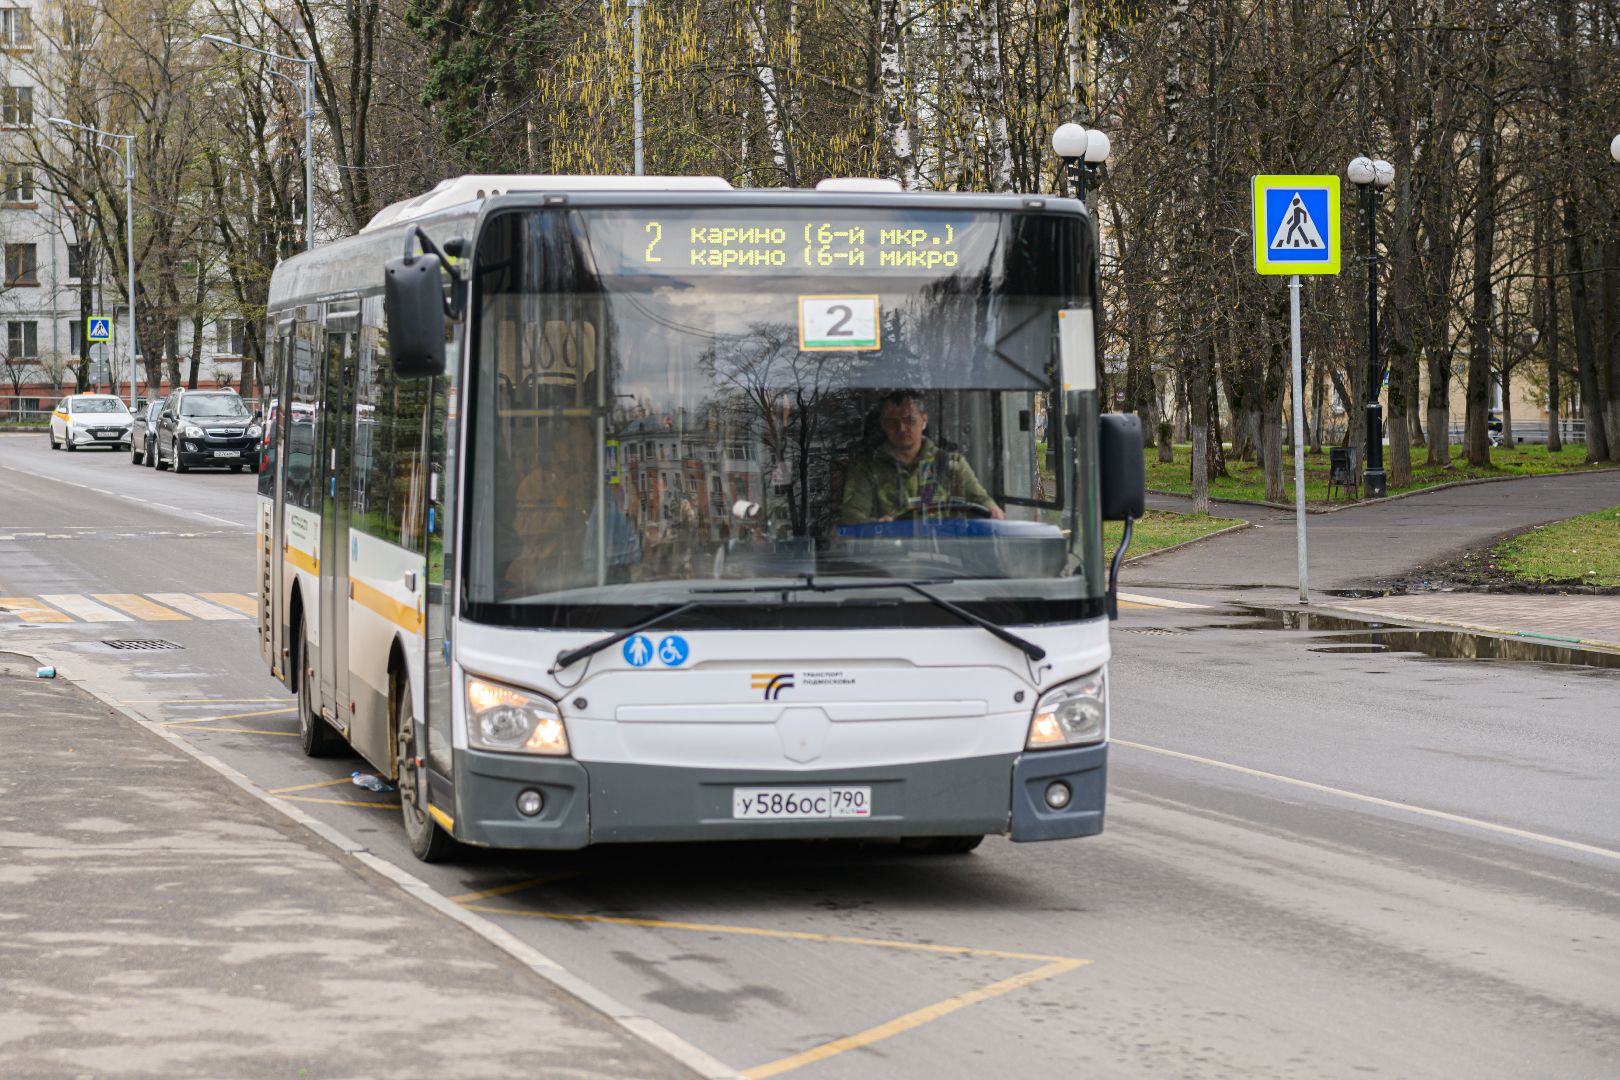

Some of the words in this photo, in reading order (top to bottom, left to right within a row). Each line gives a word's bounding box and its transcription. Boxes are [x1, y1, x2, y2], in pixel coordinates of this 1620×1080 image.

[645, 221, 662, 263] 2
[690, 227, 786, 247] карино
[804, 223, 865, 245] (6-й
[880, 223, 953, 247] мкр.)
[690, 249, 786, 268] карино
[804, 244, 865, 266] (6-й
[879, 250, 958, 269] микро
[826, 304, 854, 337] 2
[832, 791, 864, 807] 790
